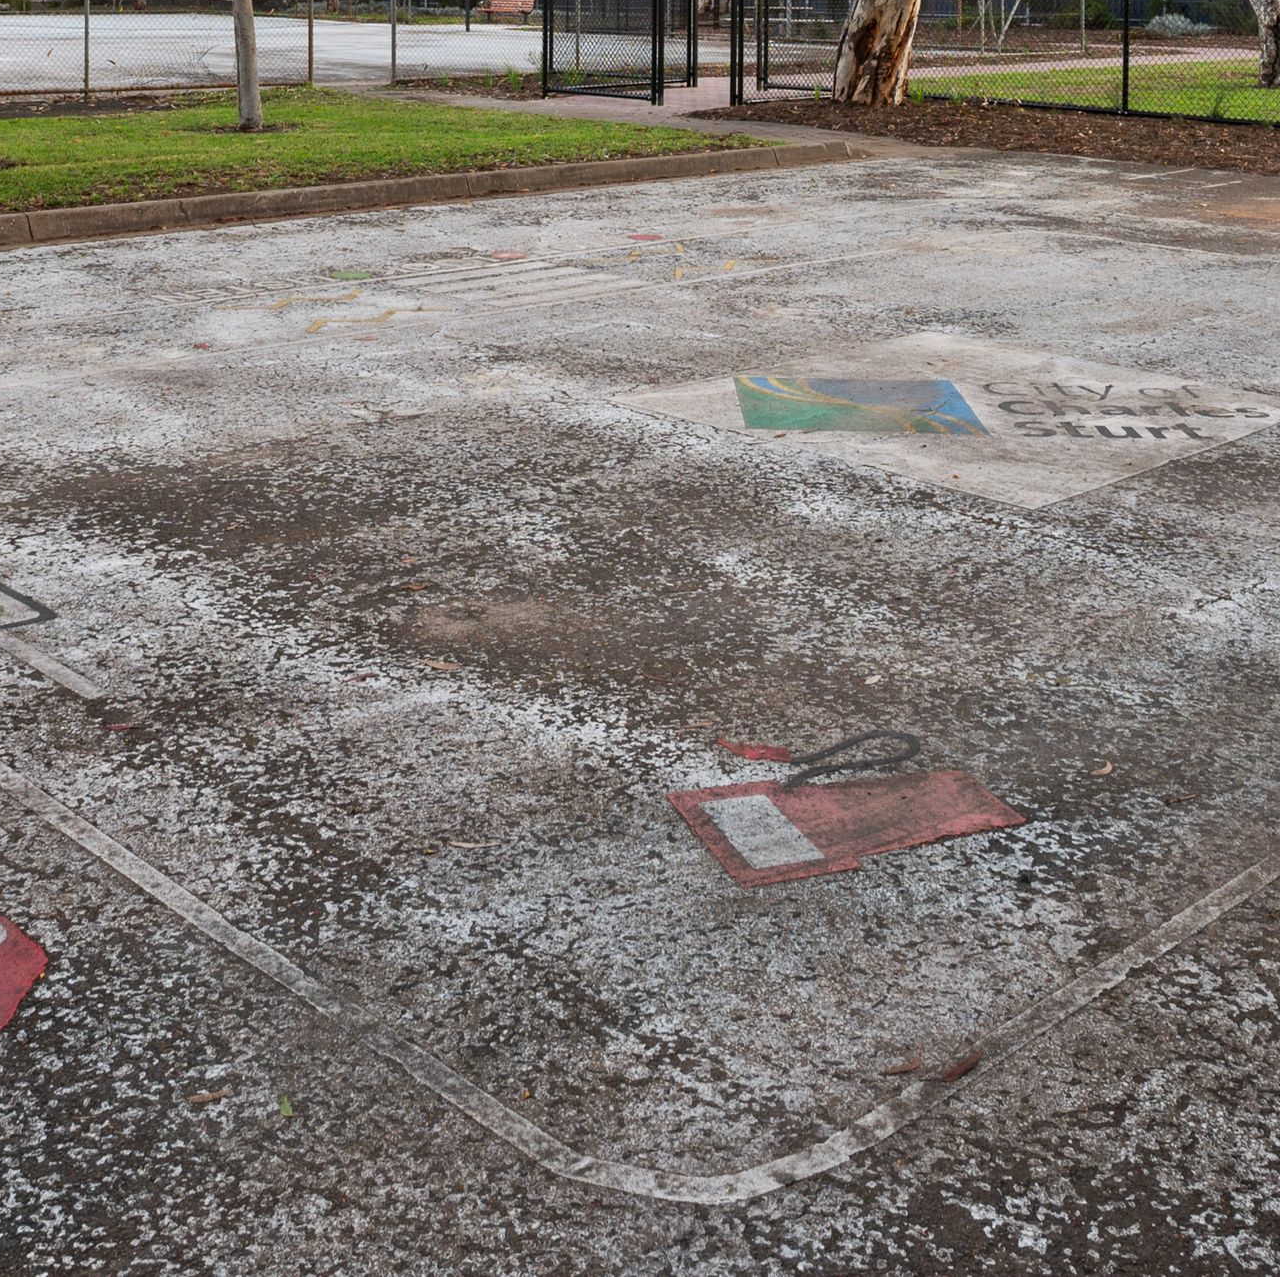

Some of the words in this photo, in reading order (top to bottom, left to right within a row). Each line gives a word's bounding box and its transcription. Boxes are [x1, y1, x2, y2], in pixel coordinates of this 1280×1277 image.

[982, 381, 1115, 401] City
[1138, 384, 1201, 399] of
[997, 399, 1271, 419] Charles
[1013, 421, 1215, 441] Sturt
